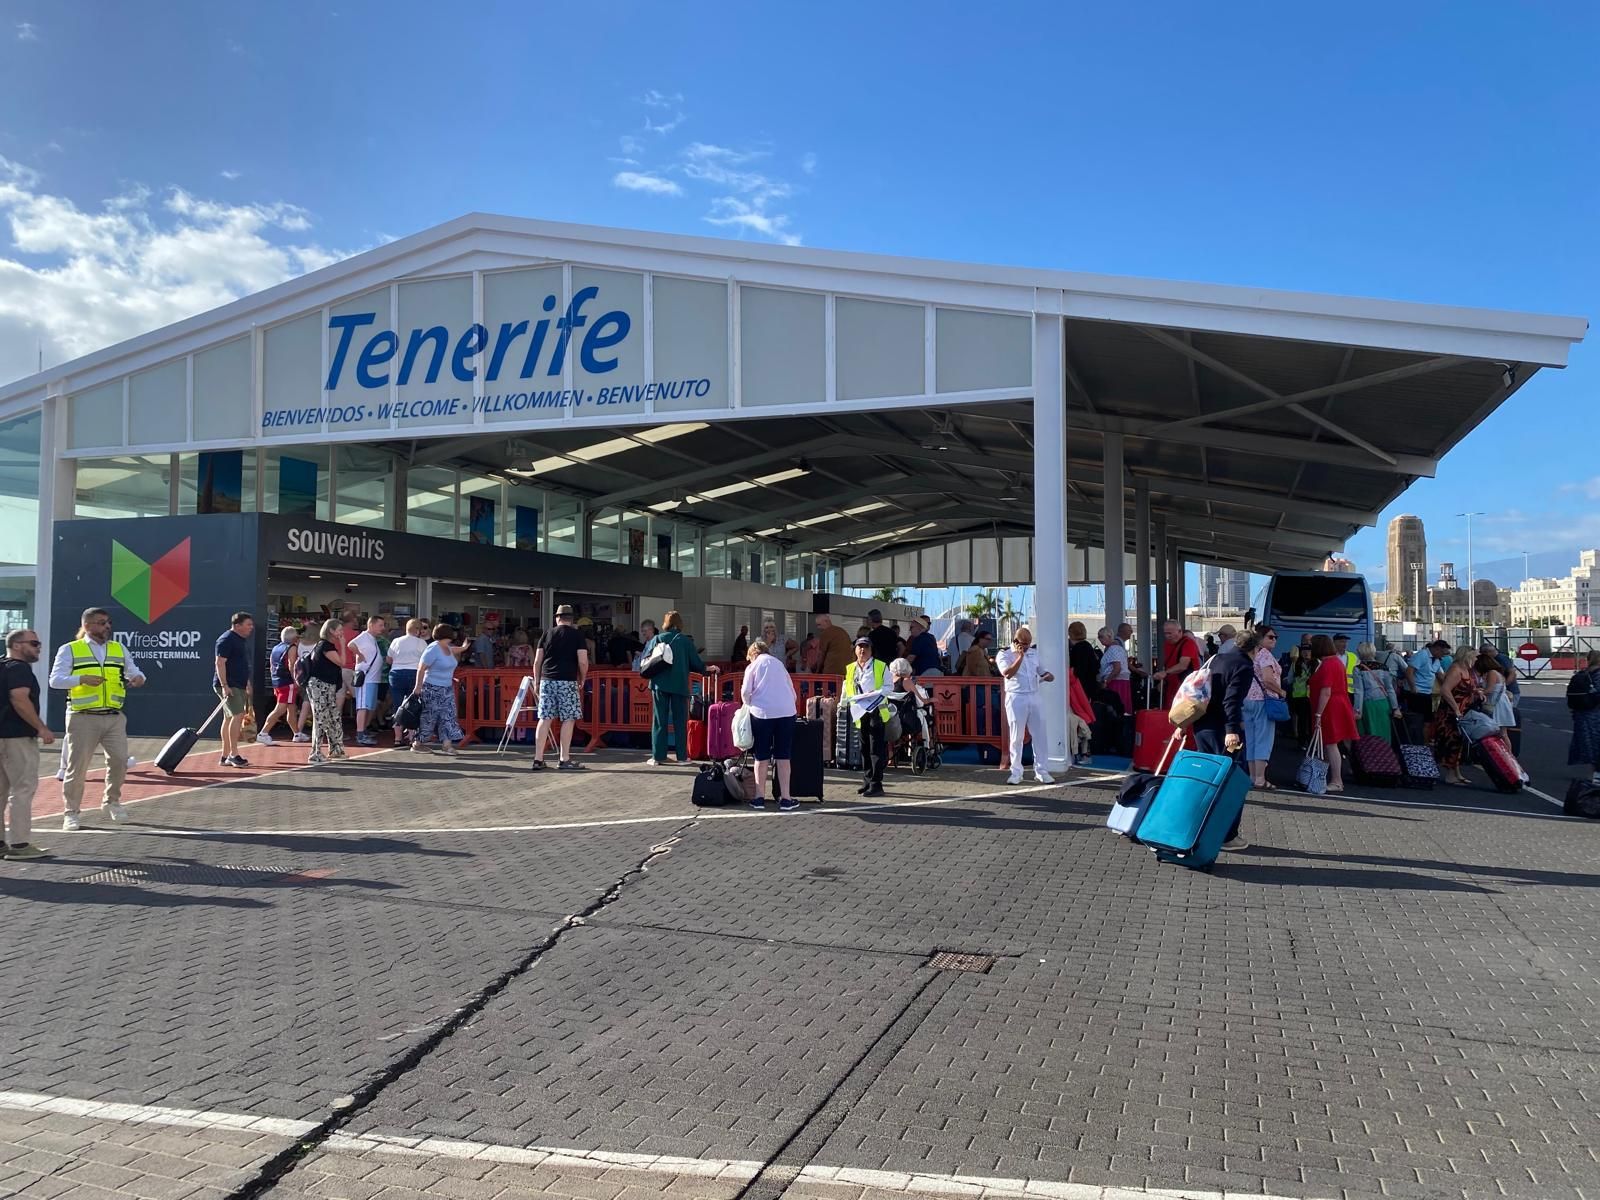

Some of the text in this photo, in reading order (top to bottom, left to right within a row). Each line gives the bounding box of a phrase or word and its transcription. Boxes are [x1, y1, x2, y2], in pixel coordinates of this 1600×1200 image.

[324, 286, 631, 391] Tenerife
[261, 404, 366, 427] BIENVENIDOS
[377, 398, 460, 420] WELCOME
[596, 378, 711, 406] BENVENUTO
